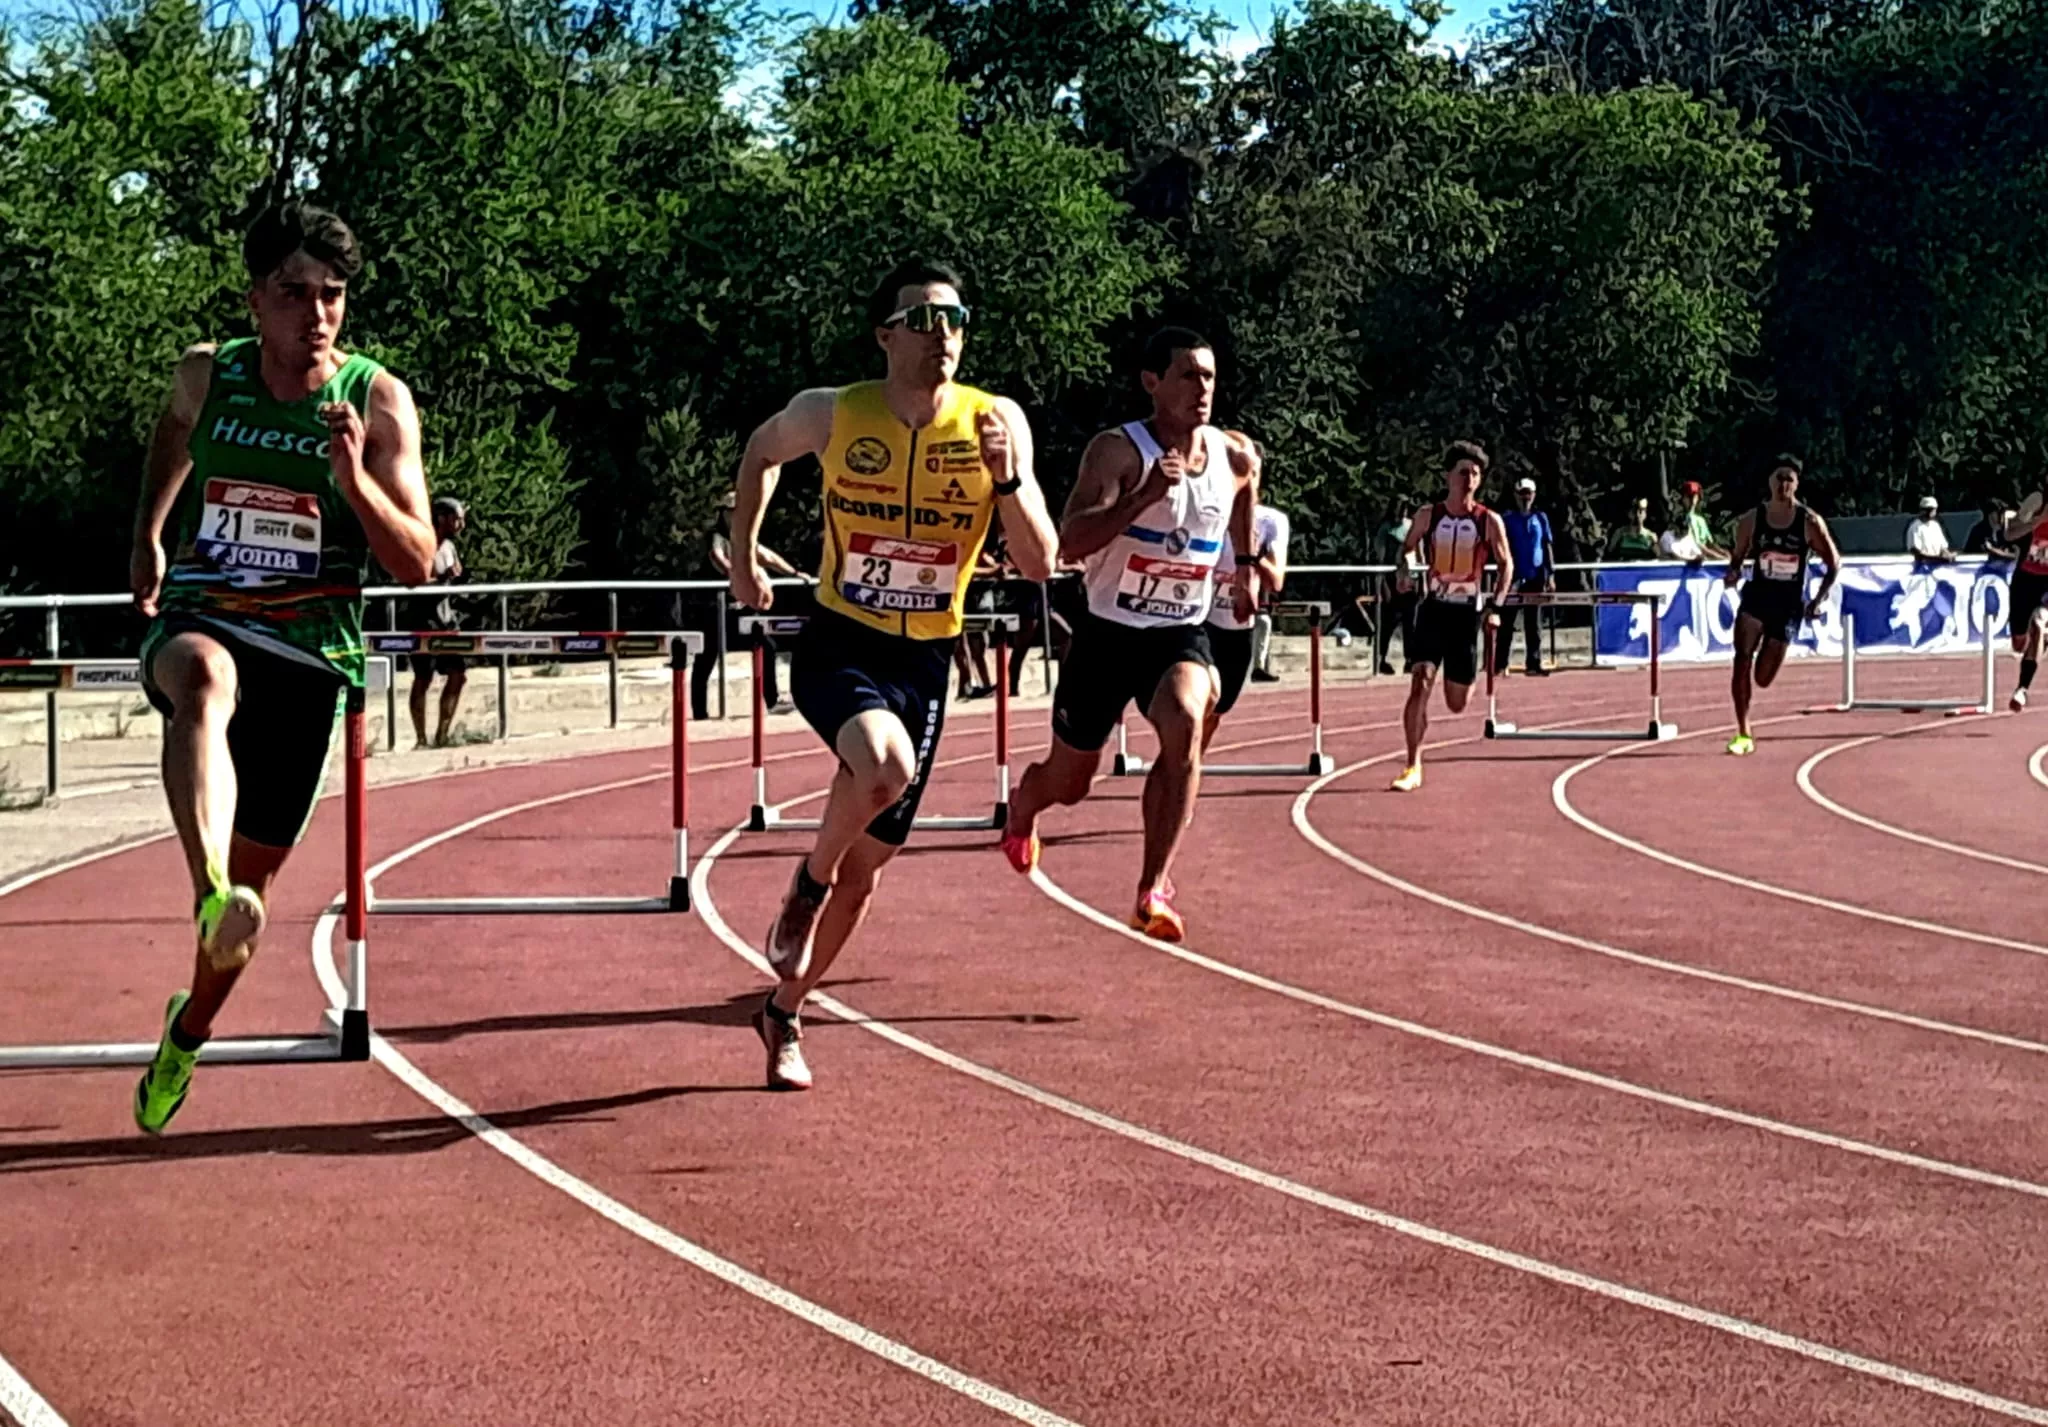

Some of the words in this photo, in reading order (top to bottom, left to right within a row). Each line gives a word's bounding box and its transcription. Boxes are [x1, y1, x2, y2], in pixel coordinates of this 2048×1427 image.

[215, 508, 243, 541] 21
[861, 557, 892, 588] 23
[1138, 575, 1161, 598] 17
